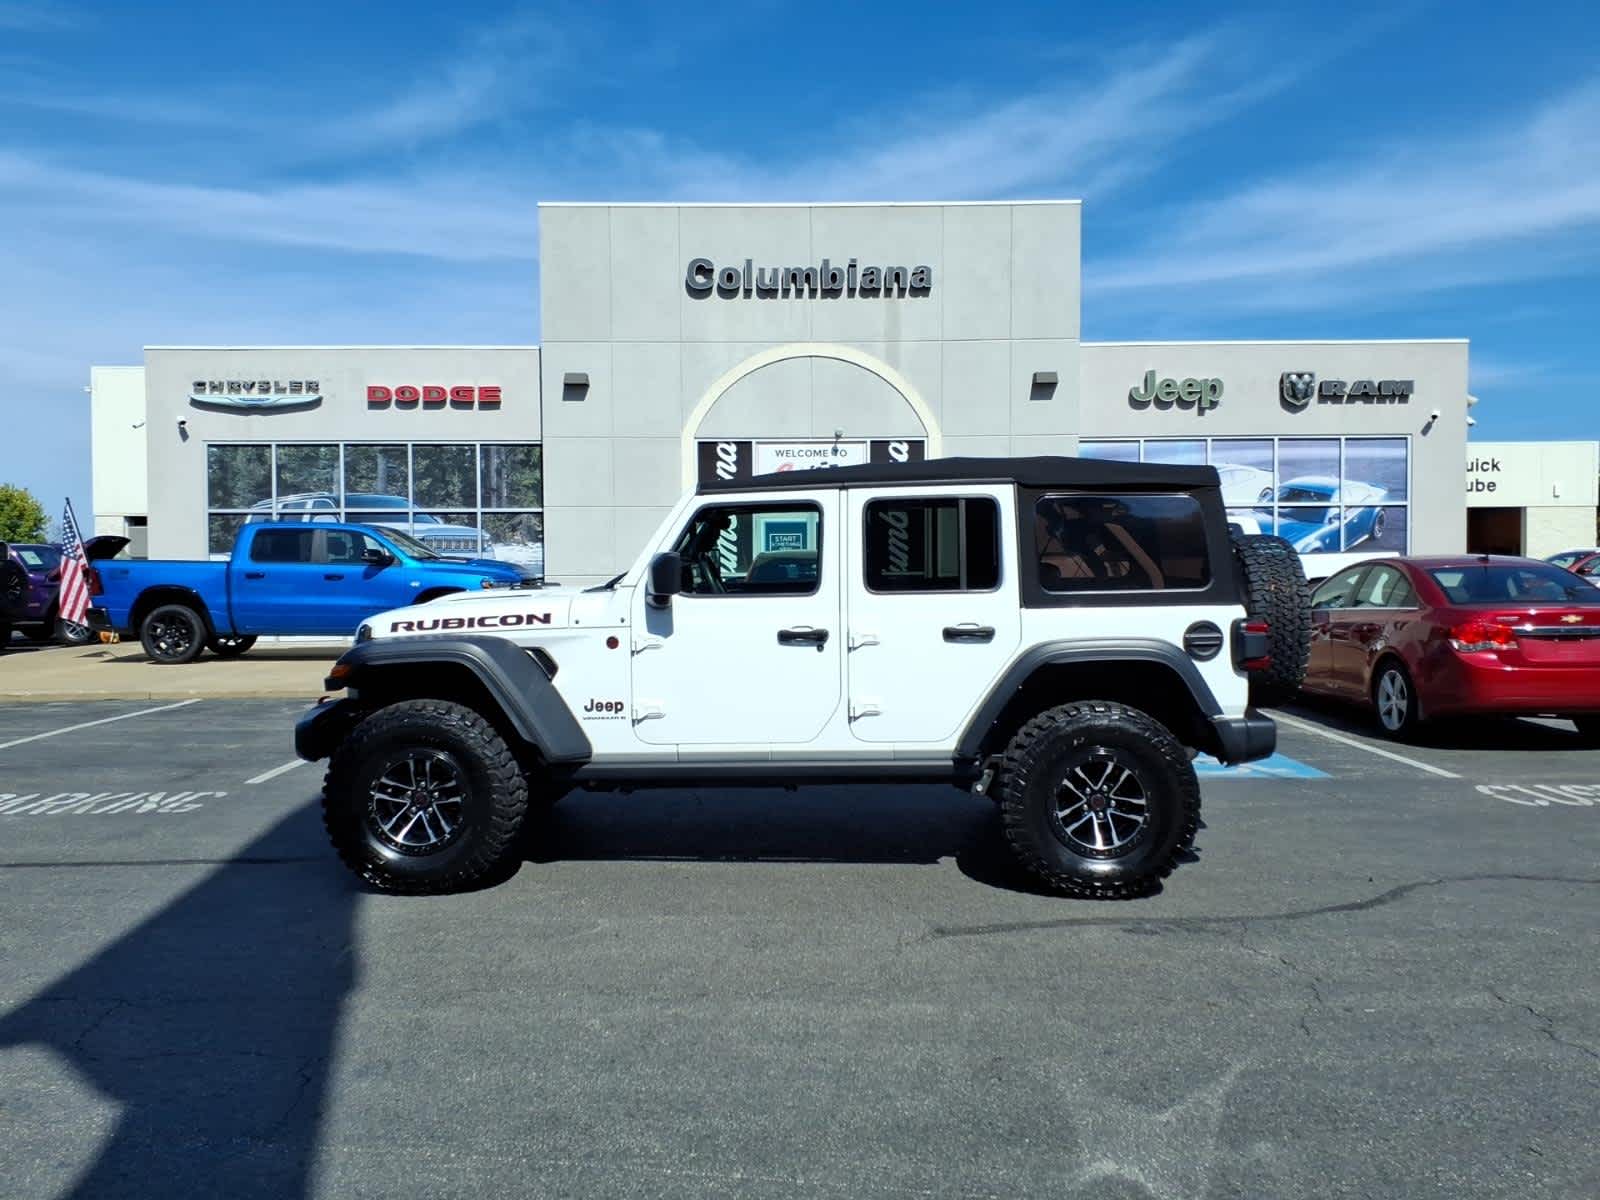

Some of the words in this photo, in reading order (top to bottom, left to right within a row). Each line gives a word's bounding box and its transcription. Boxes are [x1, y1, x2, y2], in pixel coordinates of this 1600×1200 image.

[686, 257, 932, 290] Columbiana
[193, 380, 320, 395] CHRYSLER
[367, 386, 501, 402] DODGE
[1130, 369, 1224, 407] Jeep
[1321, 380, 1415, 396] RAM
[775, 448, 829, 458] WELCOME
[832, 449, 848, 458] O
[1466, 458, 1501, 472] uick
[1466, 478, 1497, 492] ube
[774, 535, 797, 543] START
[390, 613, 552, 633] RUBICON
[584, 698, 624, 714] Jeep
